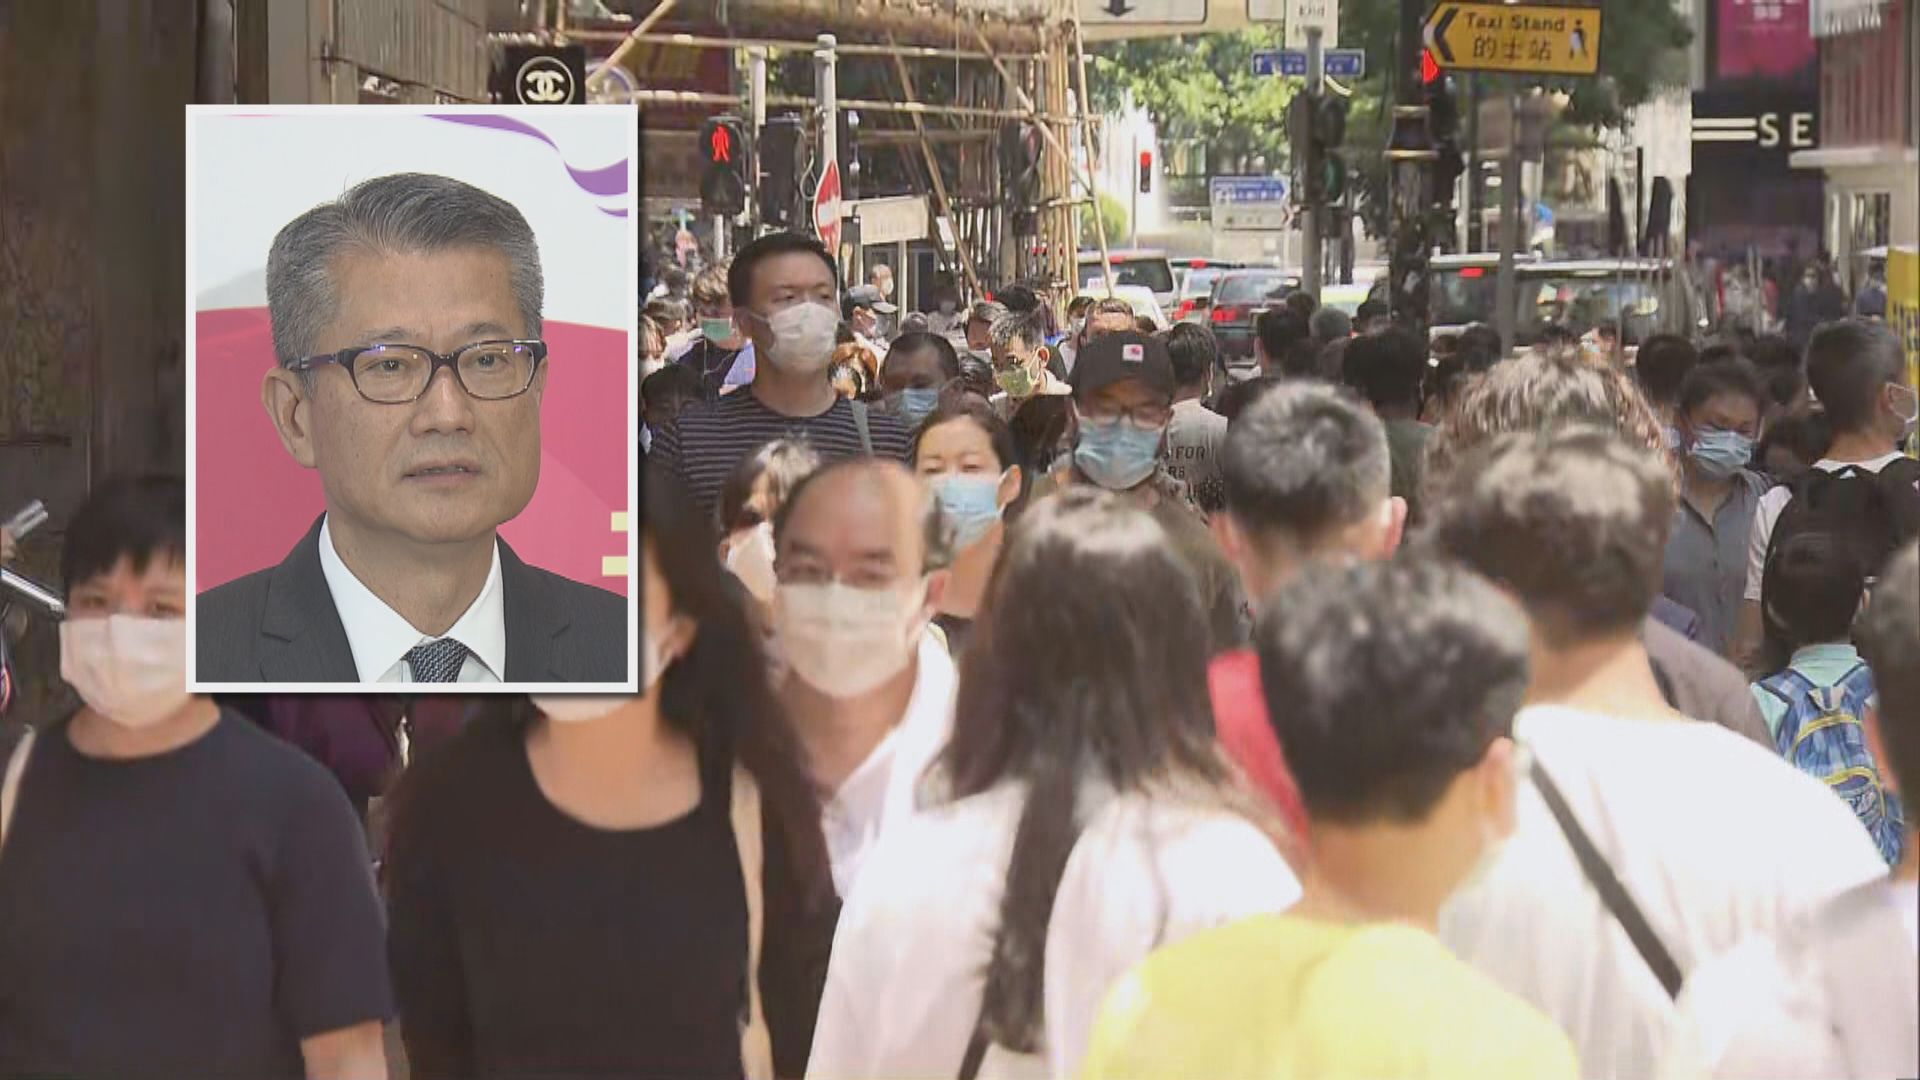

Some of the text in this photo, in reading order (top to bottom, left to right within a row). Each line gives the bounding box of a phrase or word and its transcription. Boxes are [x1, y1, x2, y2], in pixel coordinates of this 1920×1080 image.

[1464, 12, 1566, 32] Taxi Stand
[1472, 35, 1552, 63] 的士站
